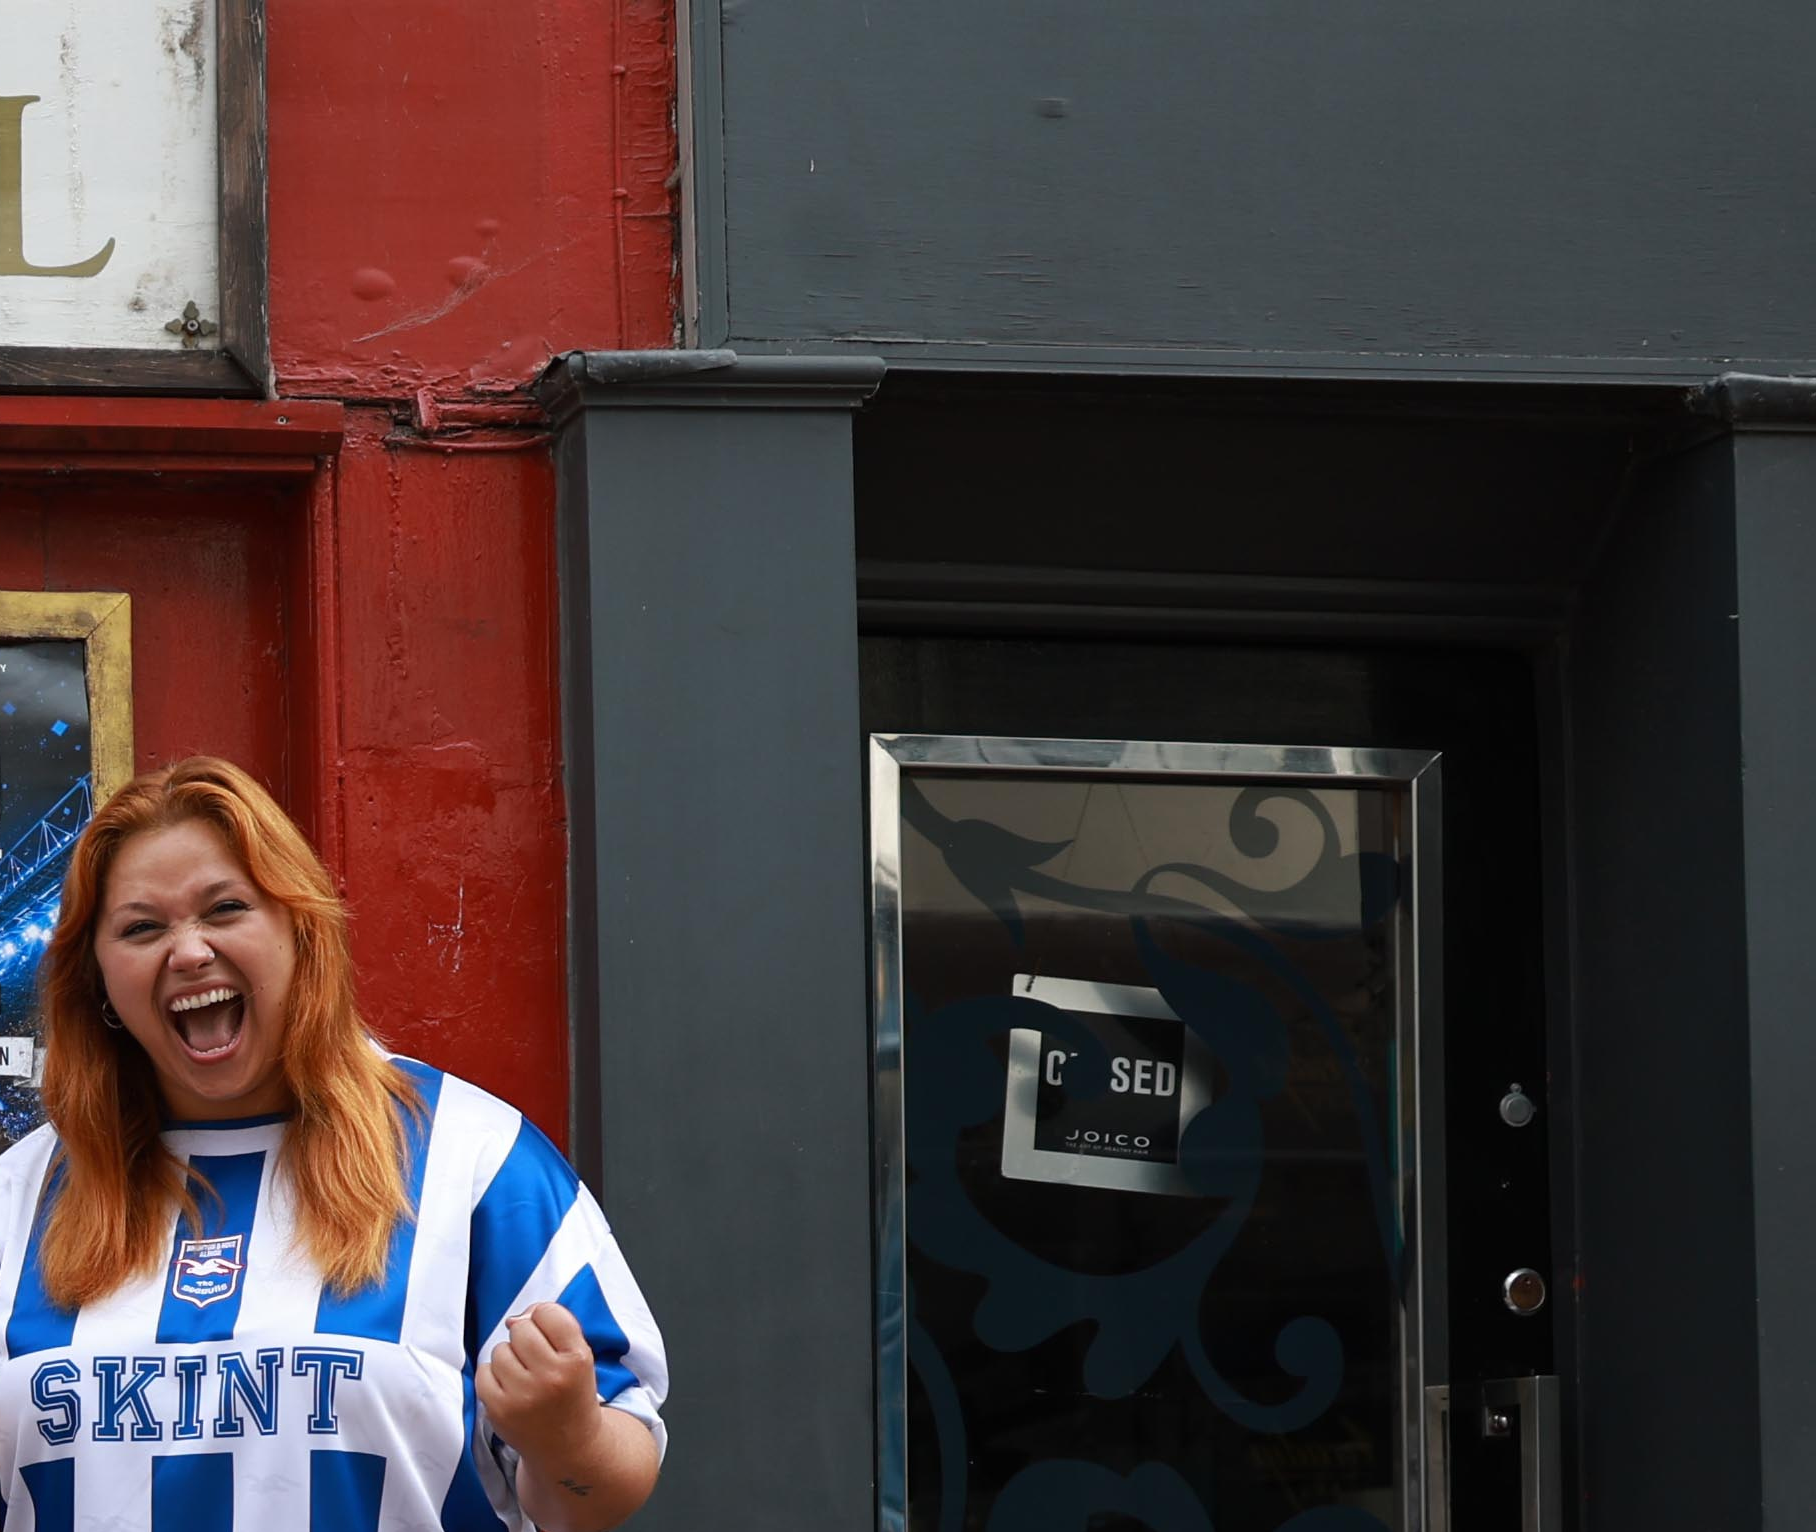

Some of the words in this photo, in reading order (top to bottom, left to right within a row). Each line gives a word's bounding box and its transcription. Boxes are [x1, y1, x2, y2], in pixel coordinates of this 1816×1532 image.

[1046, 1050, 1176, 1097] CSED
[1066, 1129, 1151, 1148] JOICO
[31, 1346, 365, 1446] SKINT
